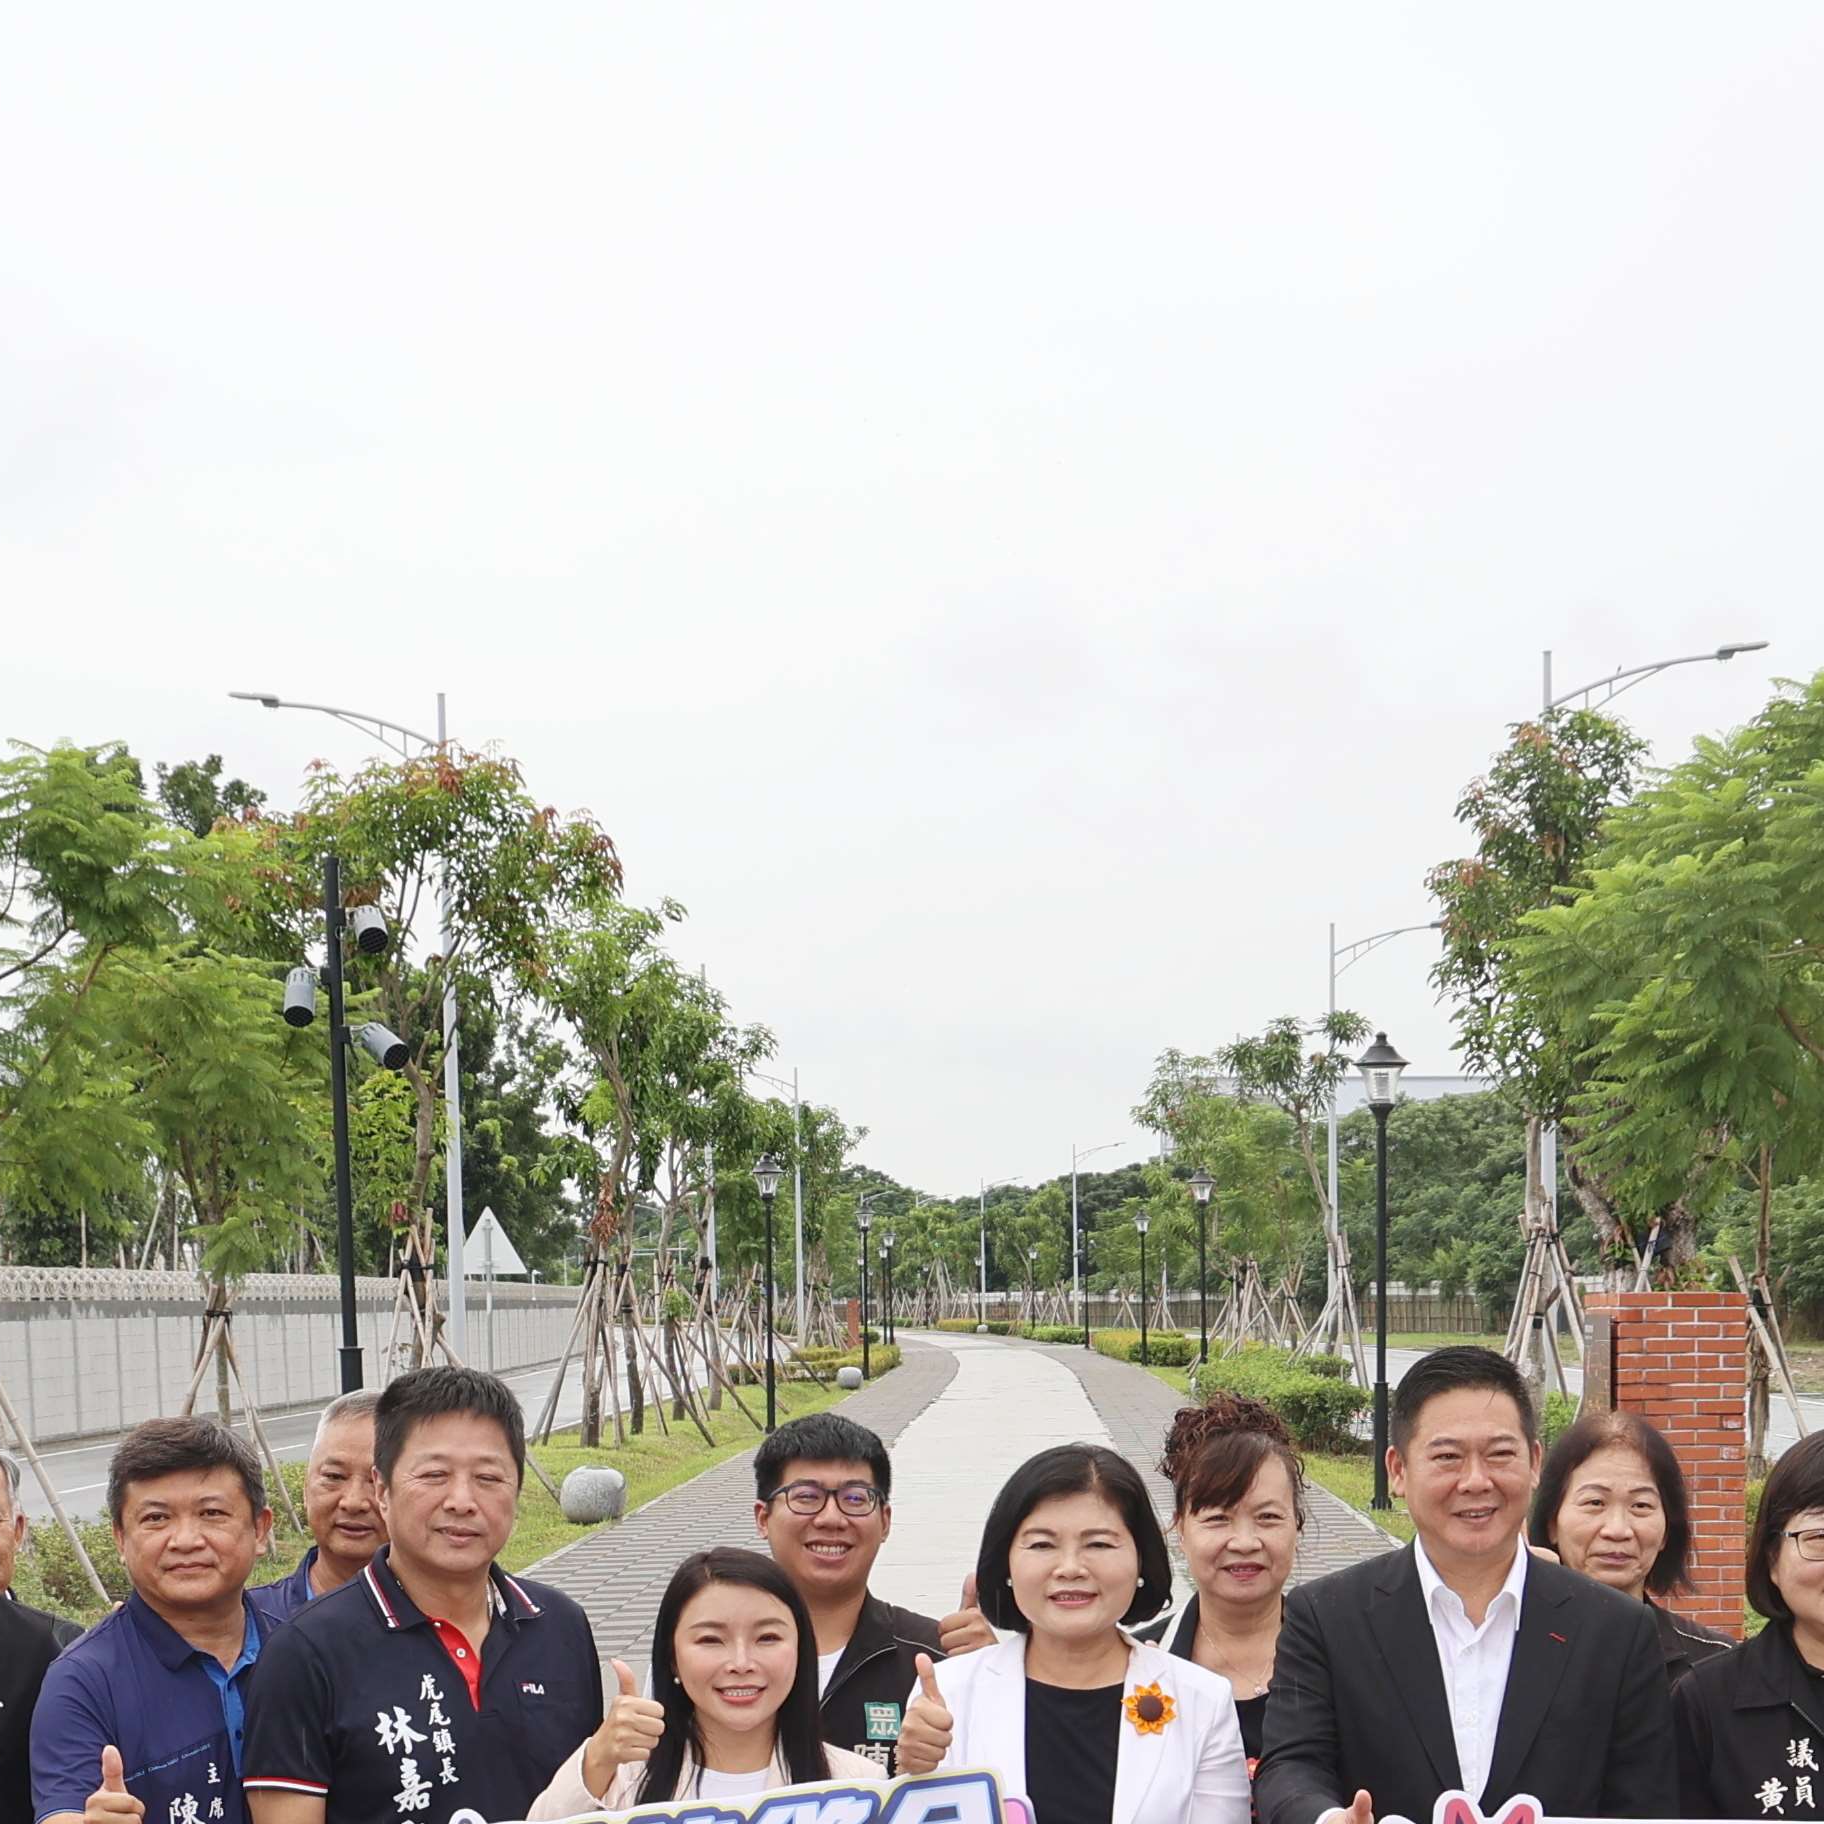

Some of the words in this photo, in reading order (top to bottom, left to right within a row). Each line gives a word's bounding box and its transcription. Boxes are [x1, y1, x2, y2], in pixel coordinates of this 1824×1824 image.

[520, 1682, 545, 1695] FILA
[419, 1673, 460, 1784] 虎尾鎮長
[207, 1762, 225, 1820] 主席
[1786, 1737, 1819, 1809] 議員
